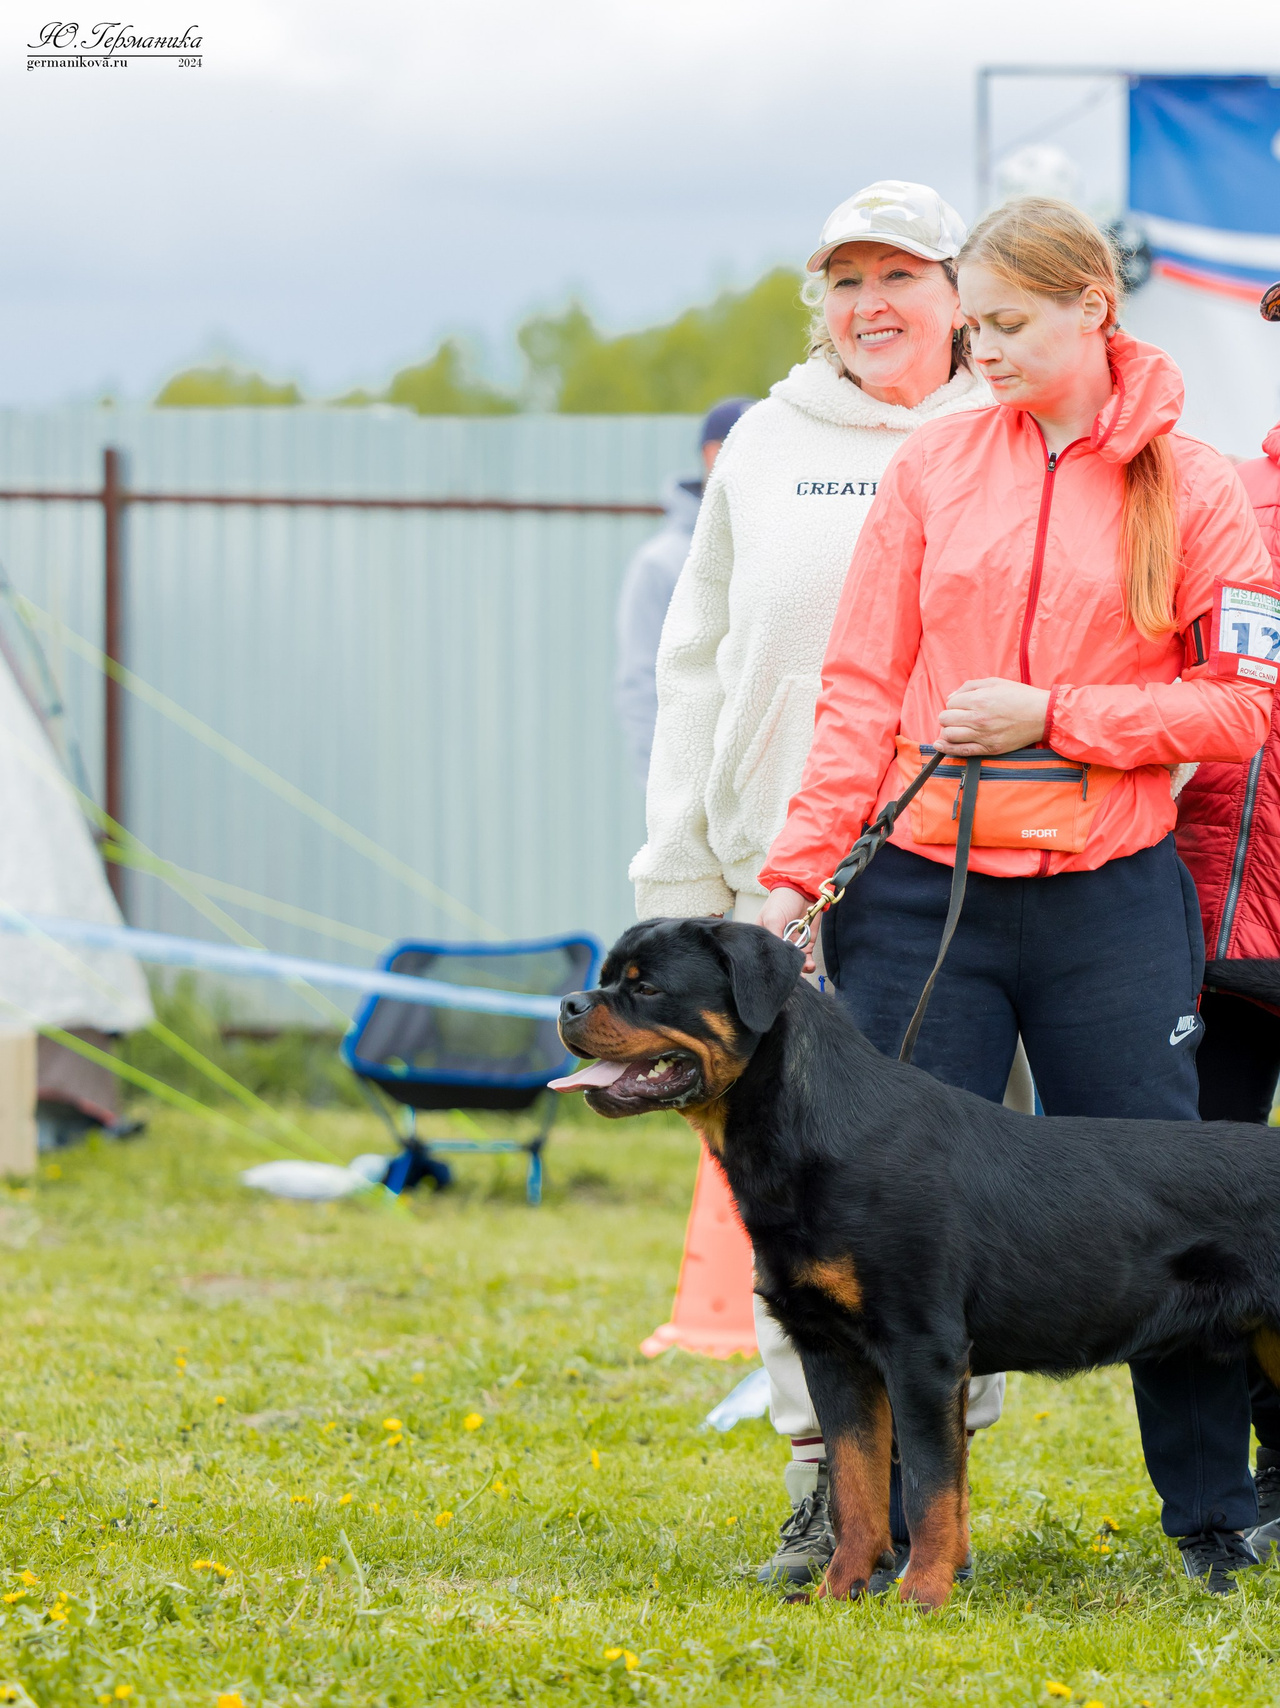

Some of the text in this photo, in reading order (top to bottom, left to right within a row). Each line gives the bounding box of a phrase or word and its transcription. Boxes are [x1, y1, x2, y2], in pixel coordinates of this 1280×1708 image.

[1240, 667, 1276, 682] ROYAL CANIN
[1021, 828, 1058, 839] SPORT
